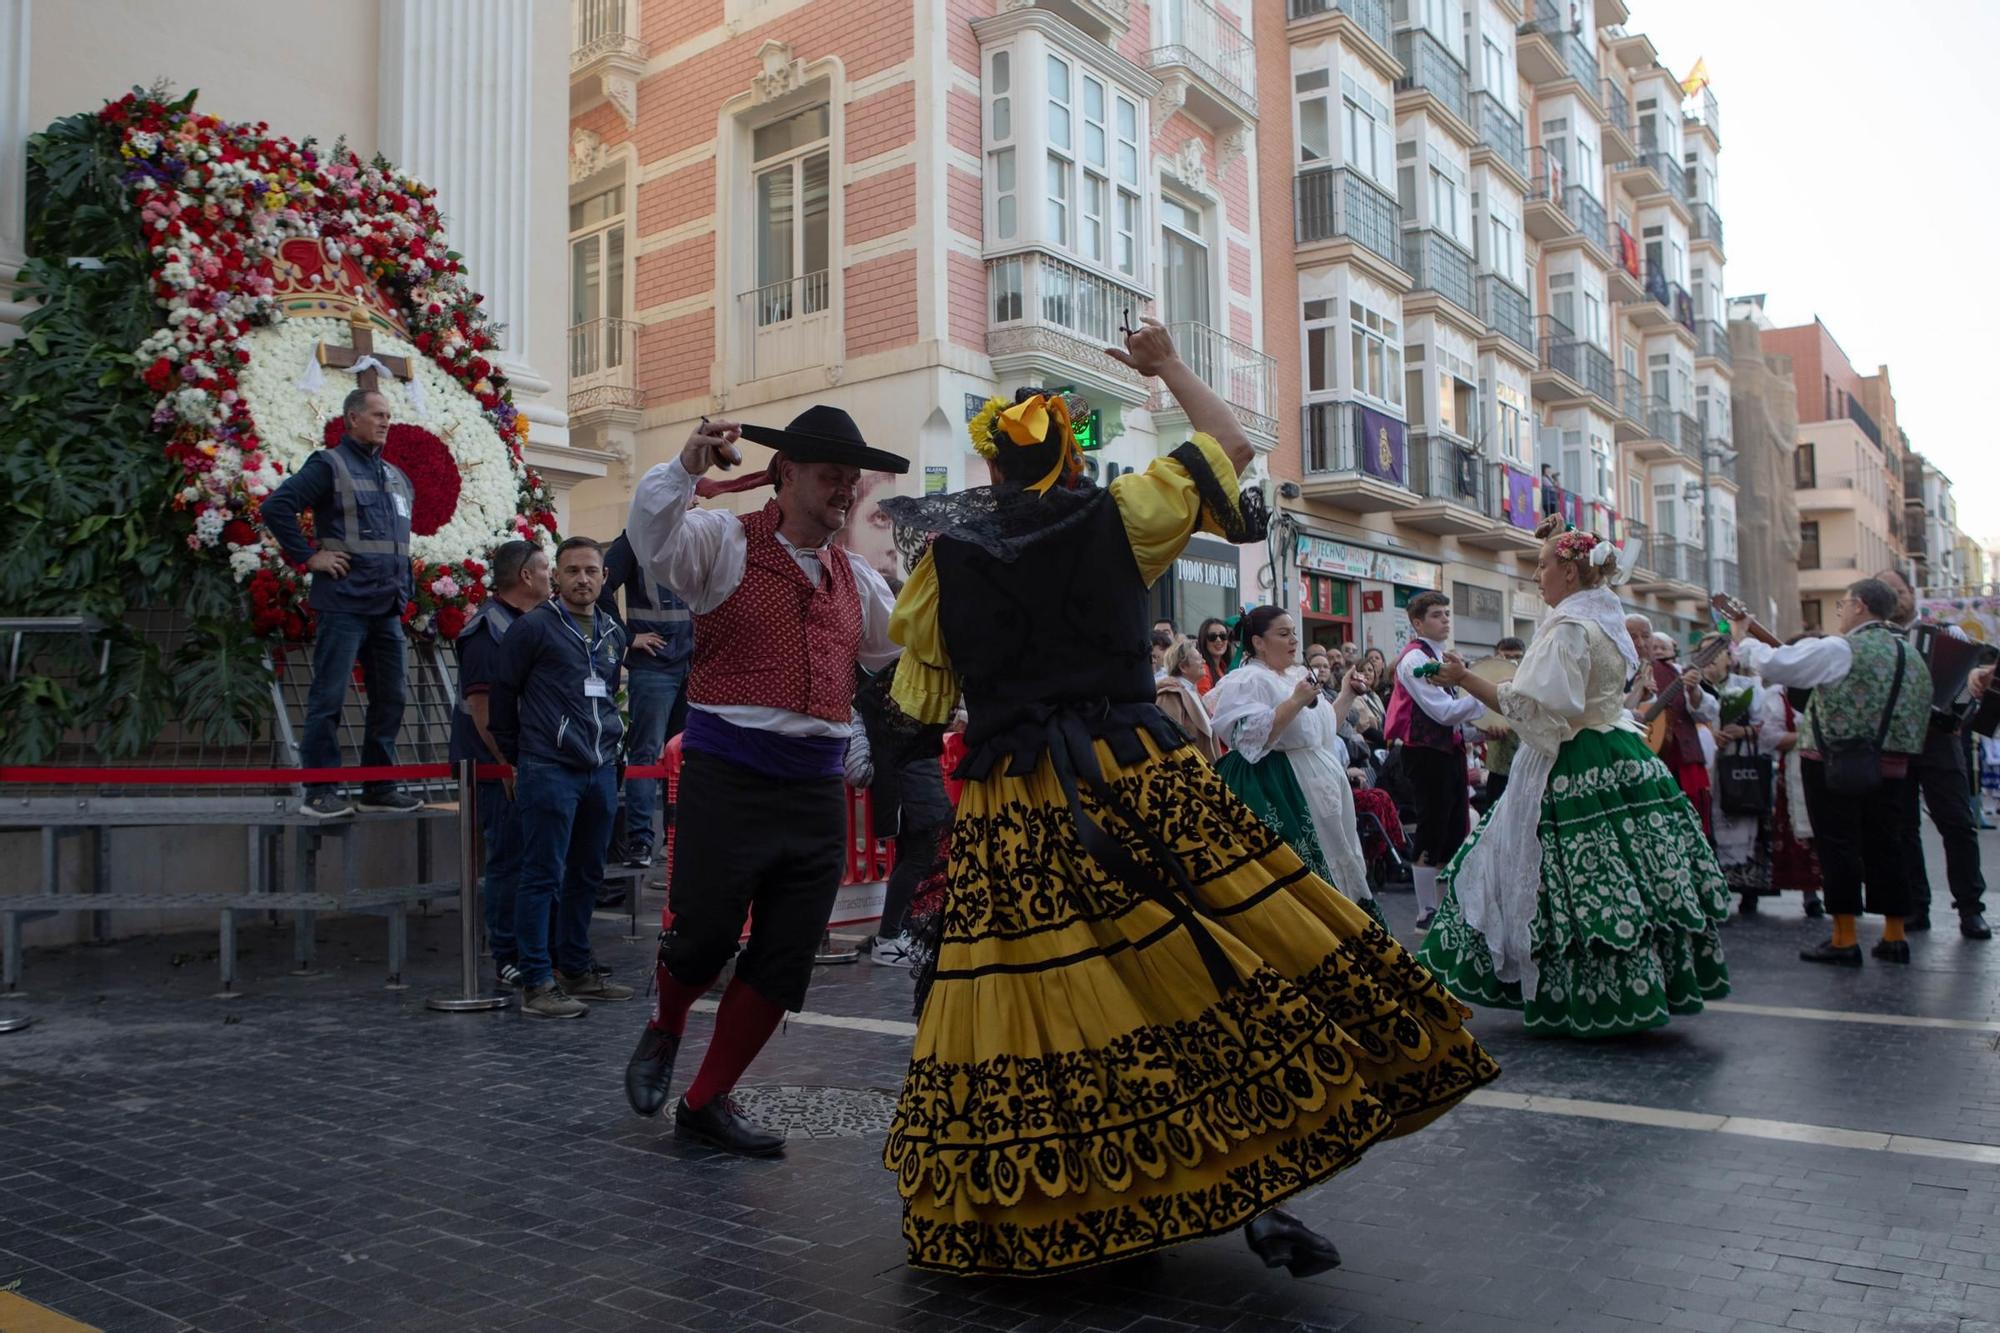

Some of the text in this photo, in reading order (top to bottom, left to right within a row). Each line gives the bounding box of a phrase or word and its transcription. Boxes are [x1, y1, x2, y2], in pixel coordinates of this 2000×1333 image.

[1177, 558, 1237, 589] TODOS LOS DÍAS
